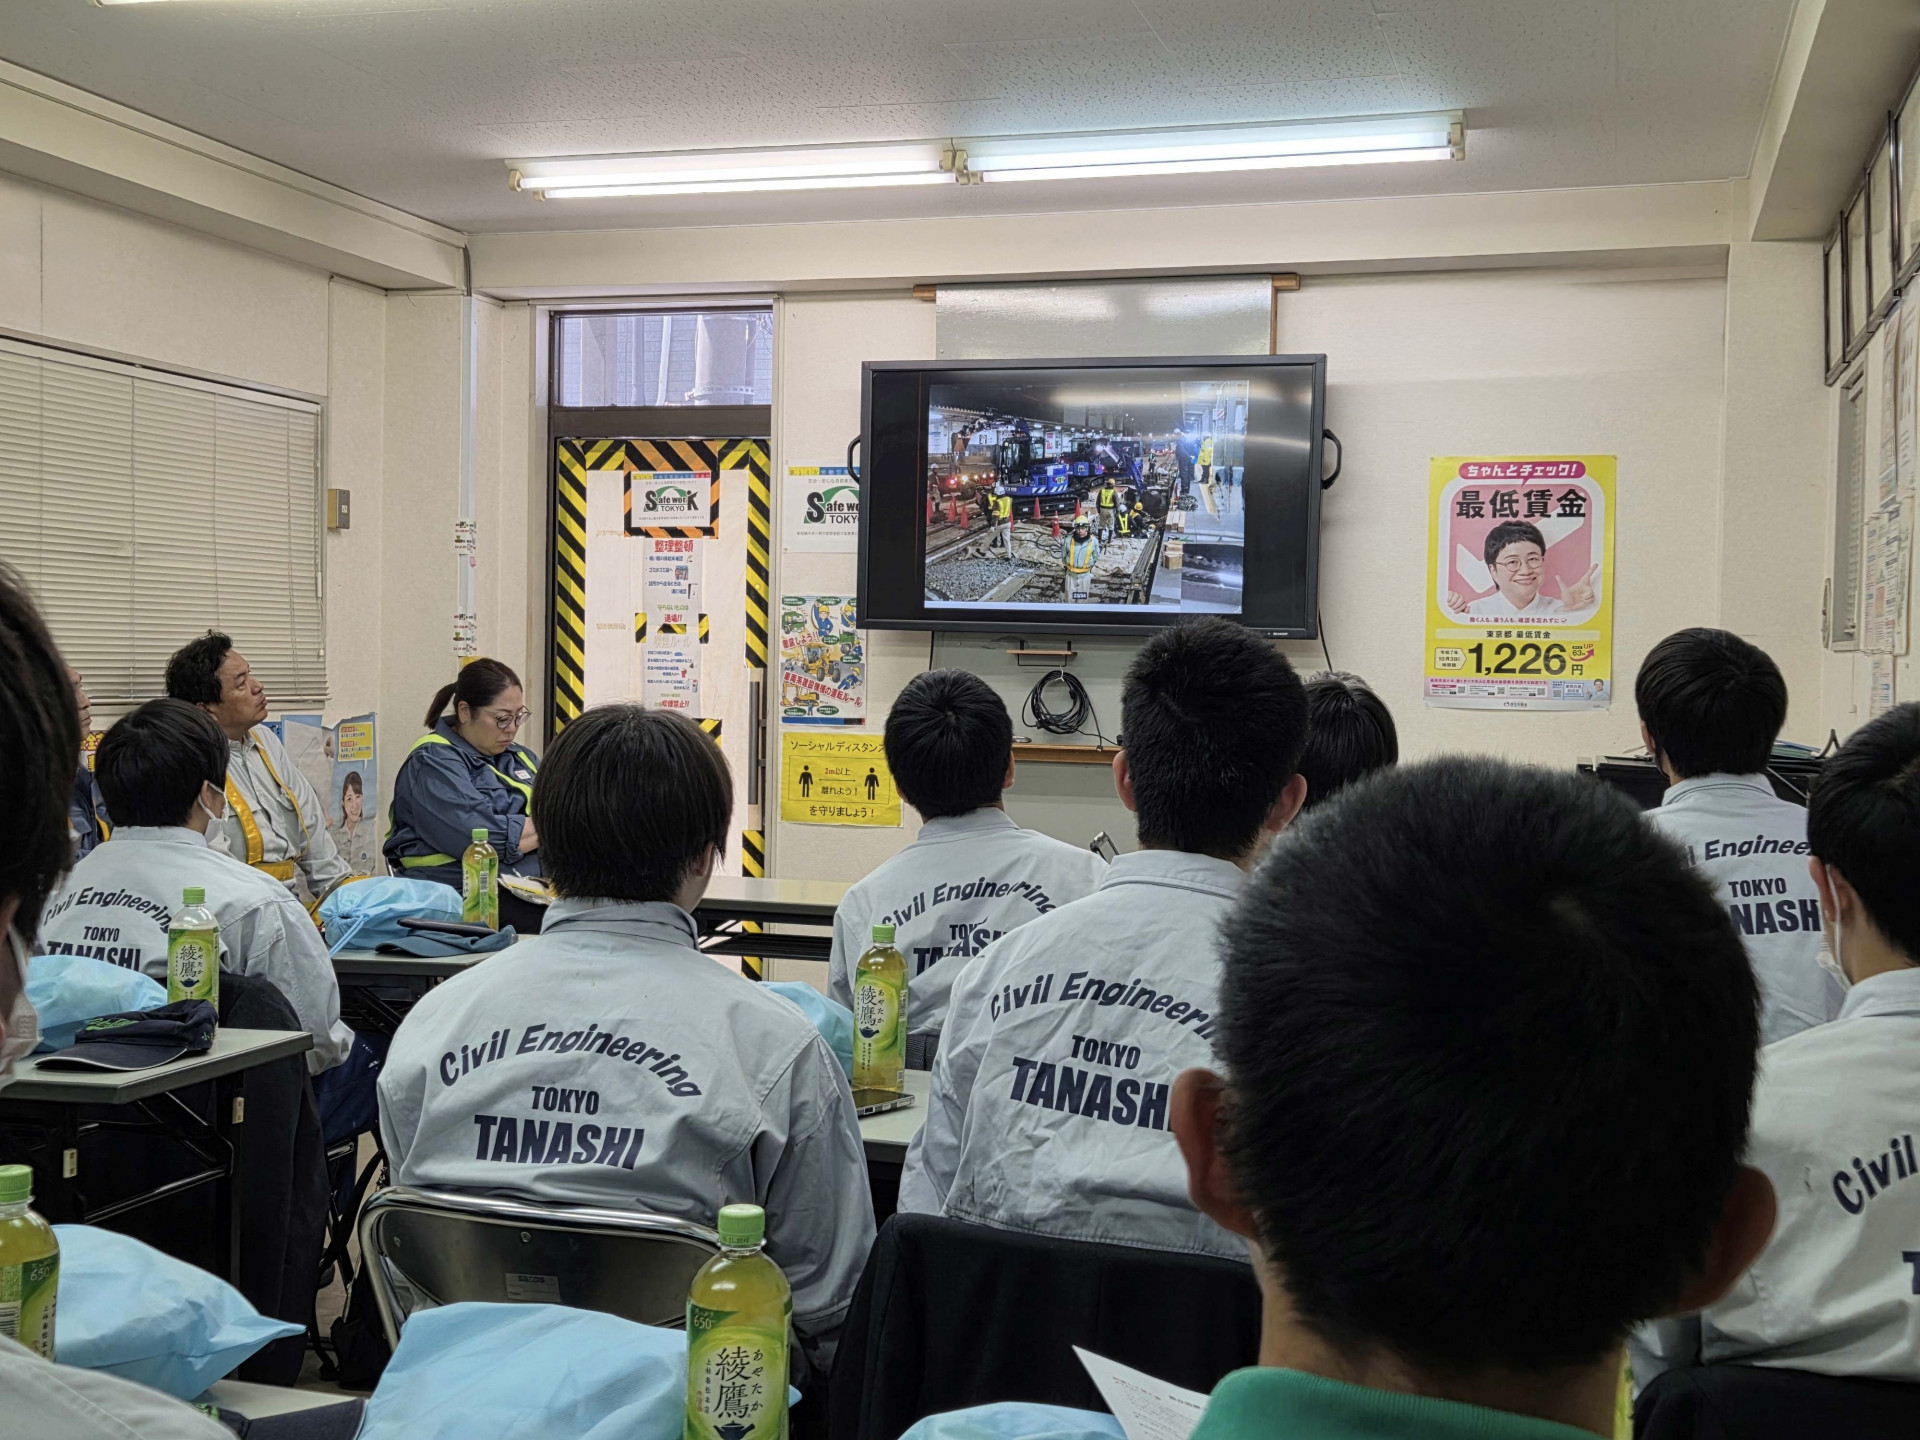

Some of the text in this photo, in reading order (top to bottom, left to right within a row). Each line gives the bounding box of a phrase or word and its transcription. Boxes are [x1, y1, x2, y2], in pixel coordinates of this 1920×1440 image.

[1467, 463, 1578, 477] ちゃんとチェック!
[806, 491, 845, 523] Safe
[829, 515, 860, 524] TOKY
[1456, 488, 1587, 519] 最低賃金
[654, 540, 694, 553] 整理整頓
[1486, 631, 1551, 639] 東京都 最低賃金
[1468, 642, 1583, 676] 1,226 円
[824, 767, 851, 776] 2m以上
[821, 786, 858, 796] 離れよう！
[809, 805, 874, 818] を守りましょう！
[1705, 834, 1812, 861] Enginee
[1728, 877, 1787, 898] TOKYO
[1729, 899, 1822, 935] NASH
[83, 926, 120, 942] TOKYO
[179, 944, 197, 978] 綾鷹
[860, 985, 877, 1027] 綾鷹
[877, 988, 885, 1024] あやたか
[991, 970, 1220, 1041] Civil Engineerin
[440, 1023, 703, 1097] Civil Engineering
[1071, 1034, 1141, 1070] TOKYO
[531, 1086, 600, 1115] TOKYO
[1010, 1056, 1174, 1132] TANASH
[474, 1114, 645, 1170] TANASHI
[1832, 1134, 1919, 1215] Civil
[693, 1315, 712, 1330] 650
[713, 1345, 751, 1419] 綾鷹
[750, 1349, 764, 1413] あやたか
